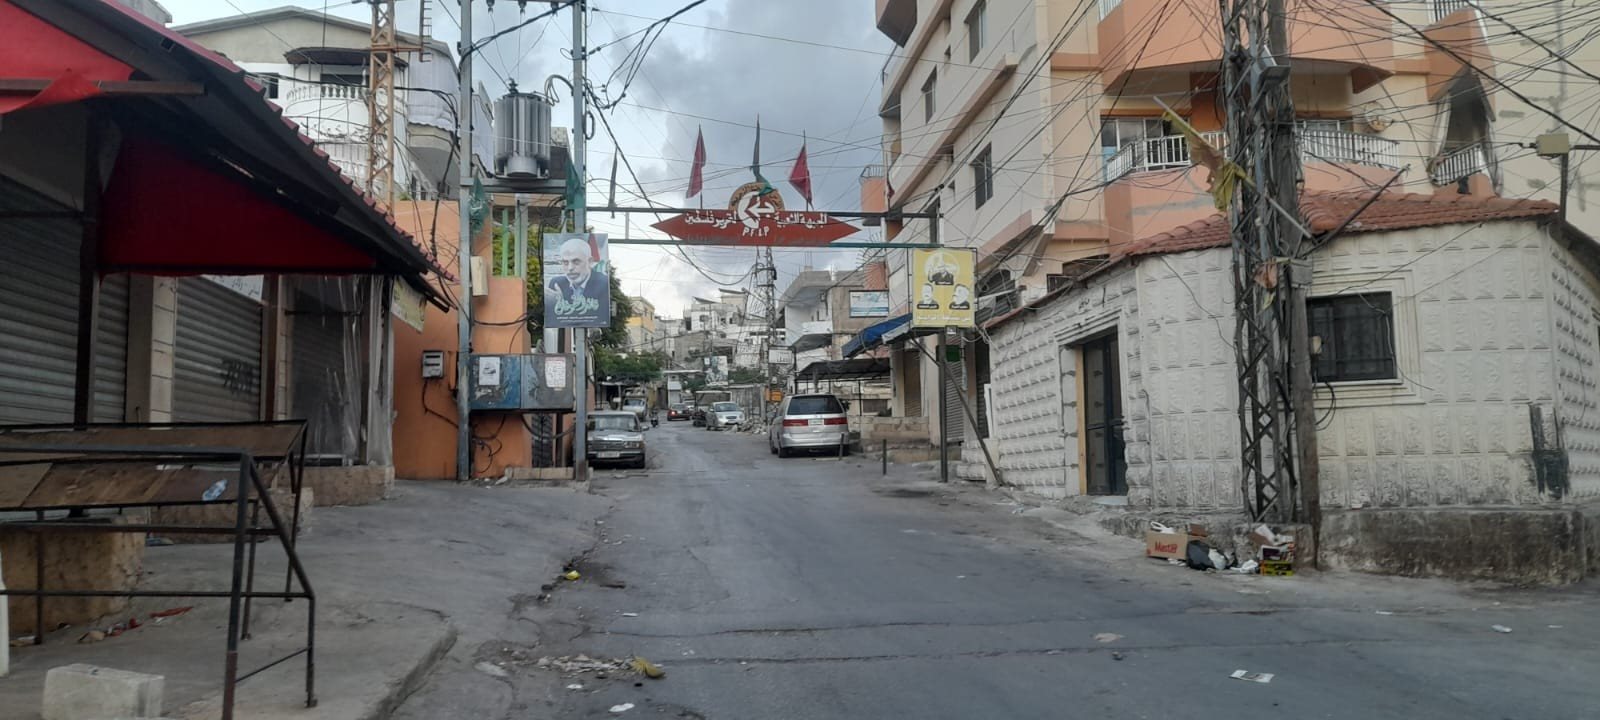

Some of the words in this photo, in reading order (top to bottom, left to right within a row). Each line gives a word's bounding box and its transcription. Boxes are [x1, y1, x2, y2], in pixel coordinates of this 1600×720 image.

[685, 209, 714, 225] فلسطين
[774, 212, 799, 229] الشعبية
[800, 213, 827, 230] الجبهة
